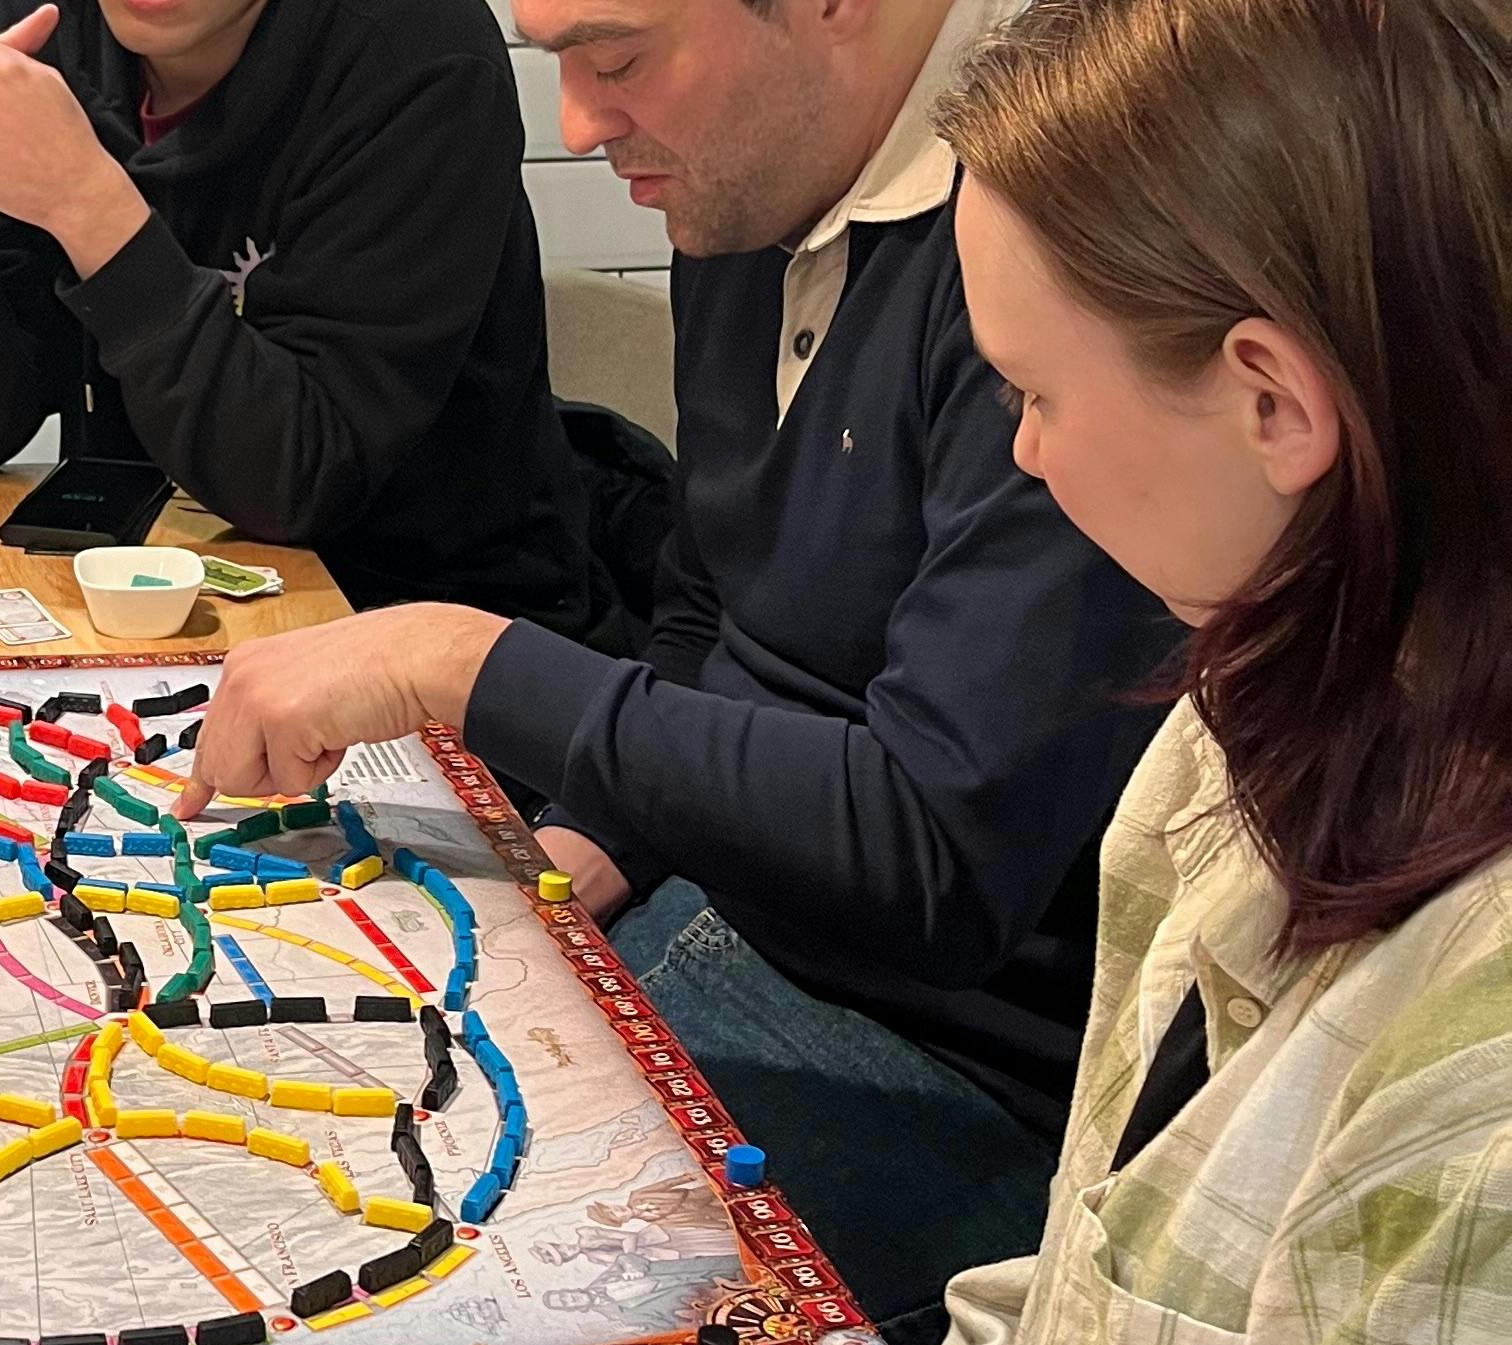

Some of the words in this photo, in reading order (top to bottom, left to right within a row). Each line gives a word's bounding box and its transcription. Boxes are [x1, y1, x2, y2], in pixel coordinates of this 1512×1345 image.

[551, 908, 576, 924] 85
[567, 931, 589, 946] 86
[582, 953, 605, 968] 87
[598, 975, 621, 992] 88
[615, 997, 638, 1016] 89
[634, 1022, 658, 1041] 90
[650, 1052, 672, 1067] 91
[668, 1078, 693, 1096] 92
[687, 1106, 712, 1125] 93
[325, 1130, 346, 1157] VEGAS
[435, 1120, 462, 1157] PHOENIX
[69, 1152, 87, 1173] CITY
[74, 1174, 93, 1199] LAKE
[79, 1200, 97, 1226] SALT
[747, 1199, 774, 1219] 96
[267, 1223, 296, 1277] FRANCISCO
[769, 1232, 800, 1251] 97
[489, 1233, 521, 1276] ANGELES
[792, 1266, 823, 1287] 98
[511, 1278, 532, 1299] LOS
[817, 1301, 846, 1324] 99
